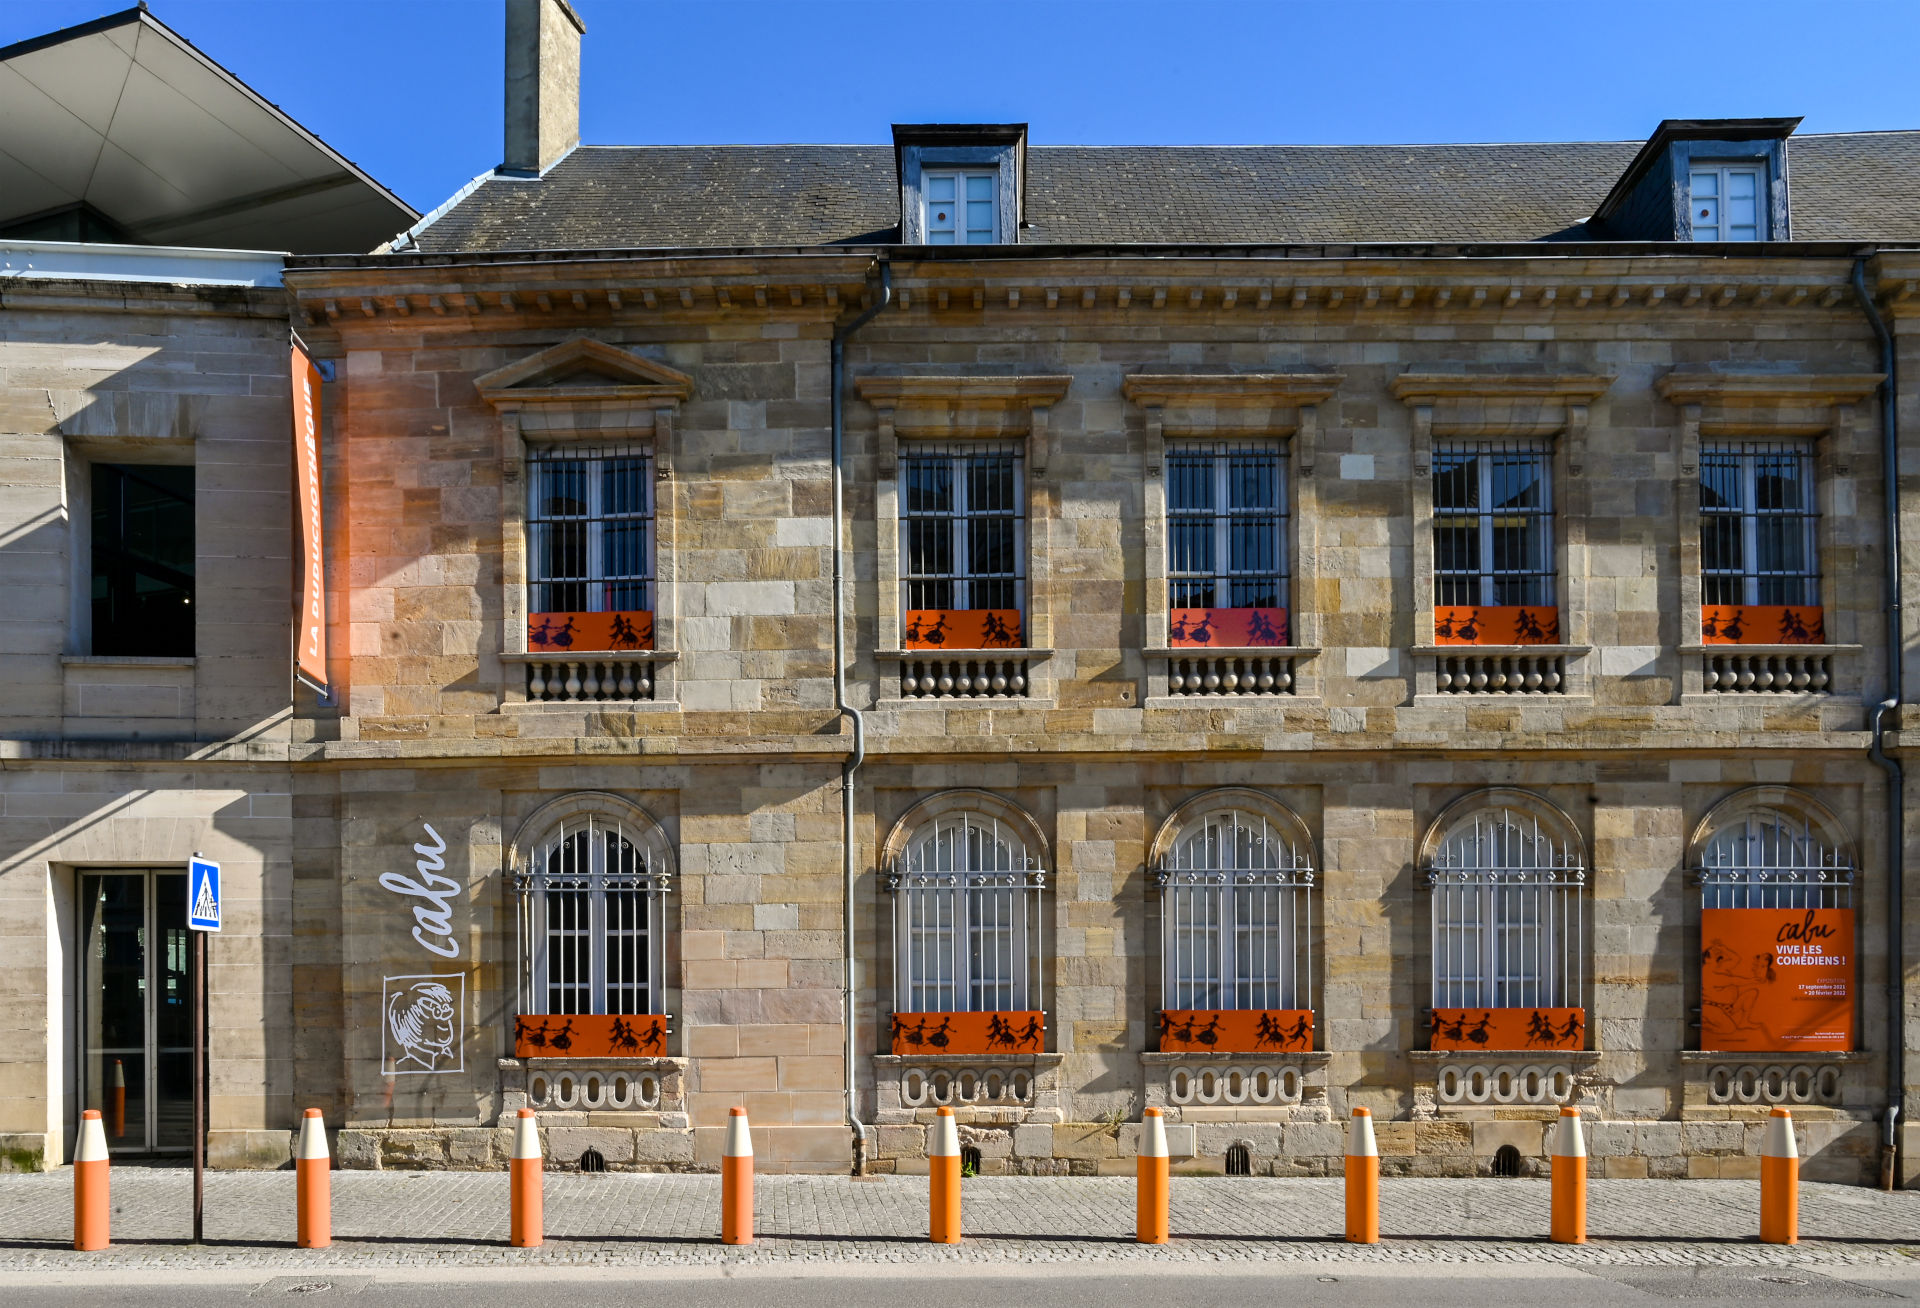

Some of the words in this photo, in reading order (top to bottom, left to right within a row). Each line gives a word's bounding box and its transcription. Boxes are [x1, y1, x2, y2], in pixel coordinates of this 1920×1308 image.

[303, 377, 320, 619] DUDUCHOTHÈQUE
[309, 626, 319, 657] LA
[378, 823, 461, 958] cabu
[1776, 909, 1836, 943] cabu
[1776, 945, 1800, 954] VIVE
[1802, 945, 1822, 954] LES
[1776, 954, 1839, 965] COMÉDIENS
